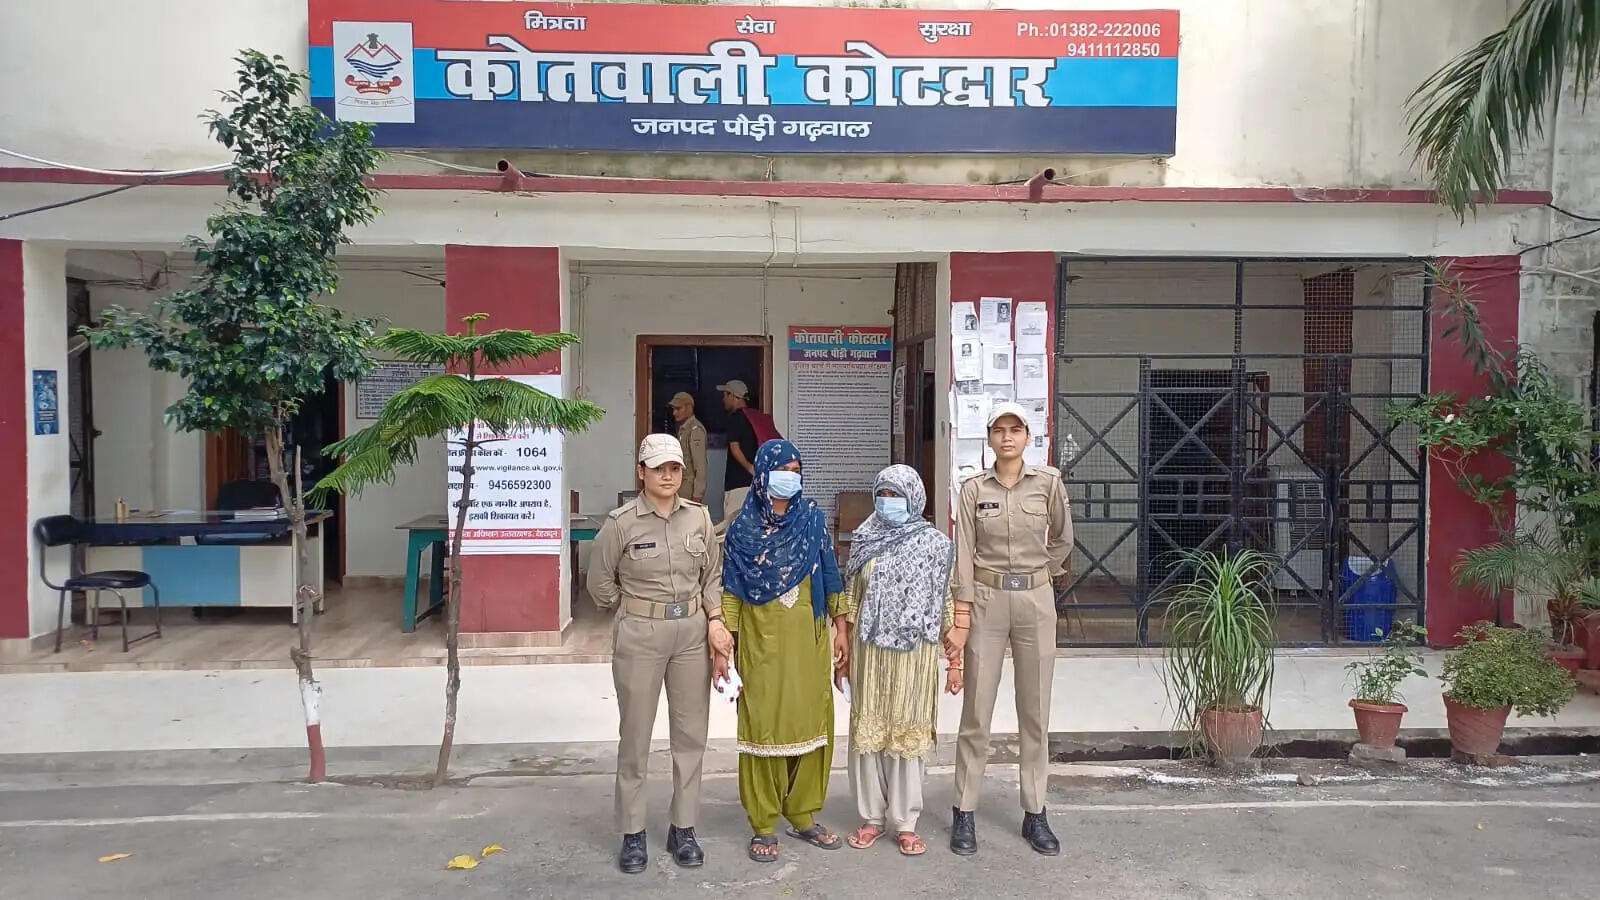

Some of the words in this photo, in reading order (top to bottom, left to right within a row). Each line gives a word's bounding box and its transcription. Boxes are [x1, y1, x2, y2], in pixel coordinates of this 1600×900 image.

[524, 11, 587, 31] मित्रता
[736, 15, 776, 34] सेवा
[918, 22, 972, 43] सुरक्षा
[1016, 22, 1161, 38] Ph.:01382-222006
[1067, 42, 1161, 57] 9411112850
[436, 36, 777, 104] कोतवाली
[796, 40, 1057, 108] कोटद्वार
[631, 118, 717, 135] जनपद
[723, 113, 776, 141] पौड़ी
[783, 120, 872, 142] गढ़वाल
[793, 329, 844, 344] कोतवाली
[804, 349, 831, 358] जनपद
[516, 447, 547, 457] 1064
[488, 480, 552, 490] 9456592300
